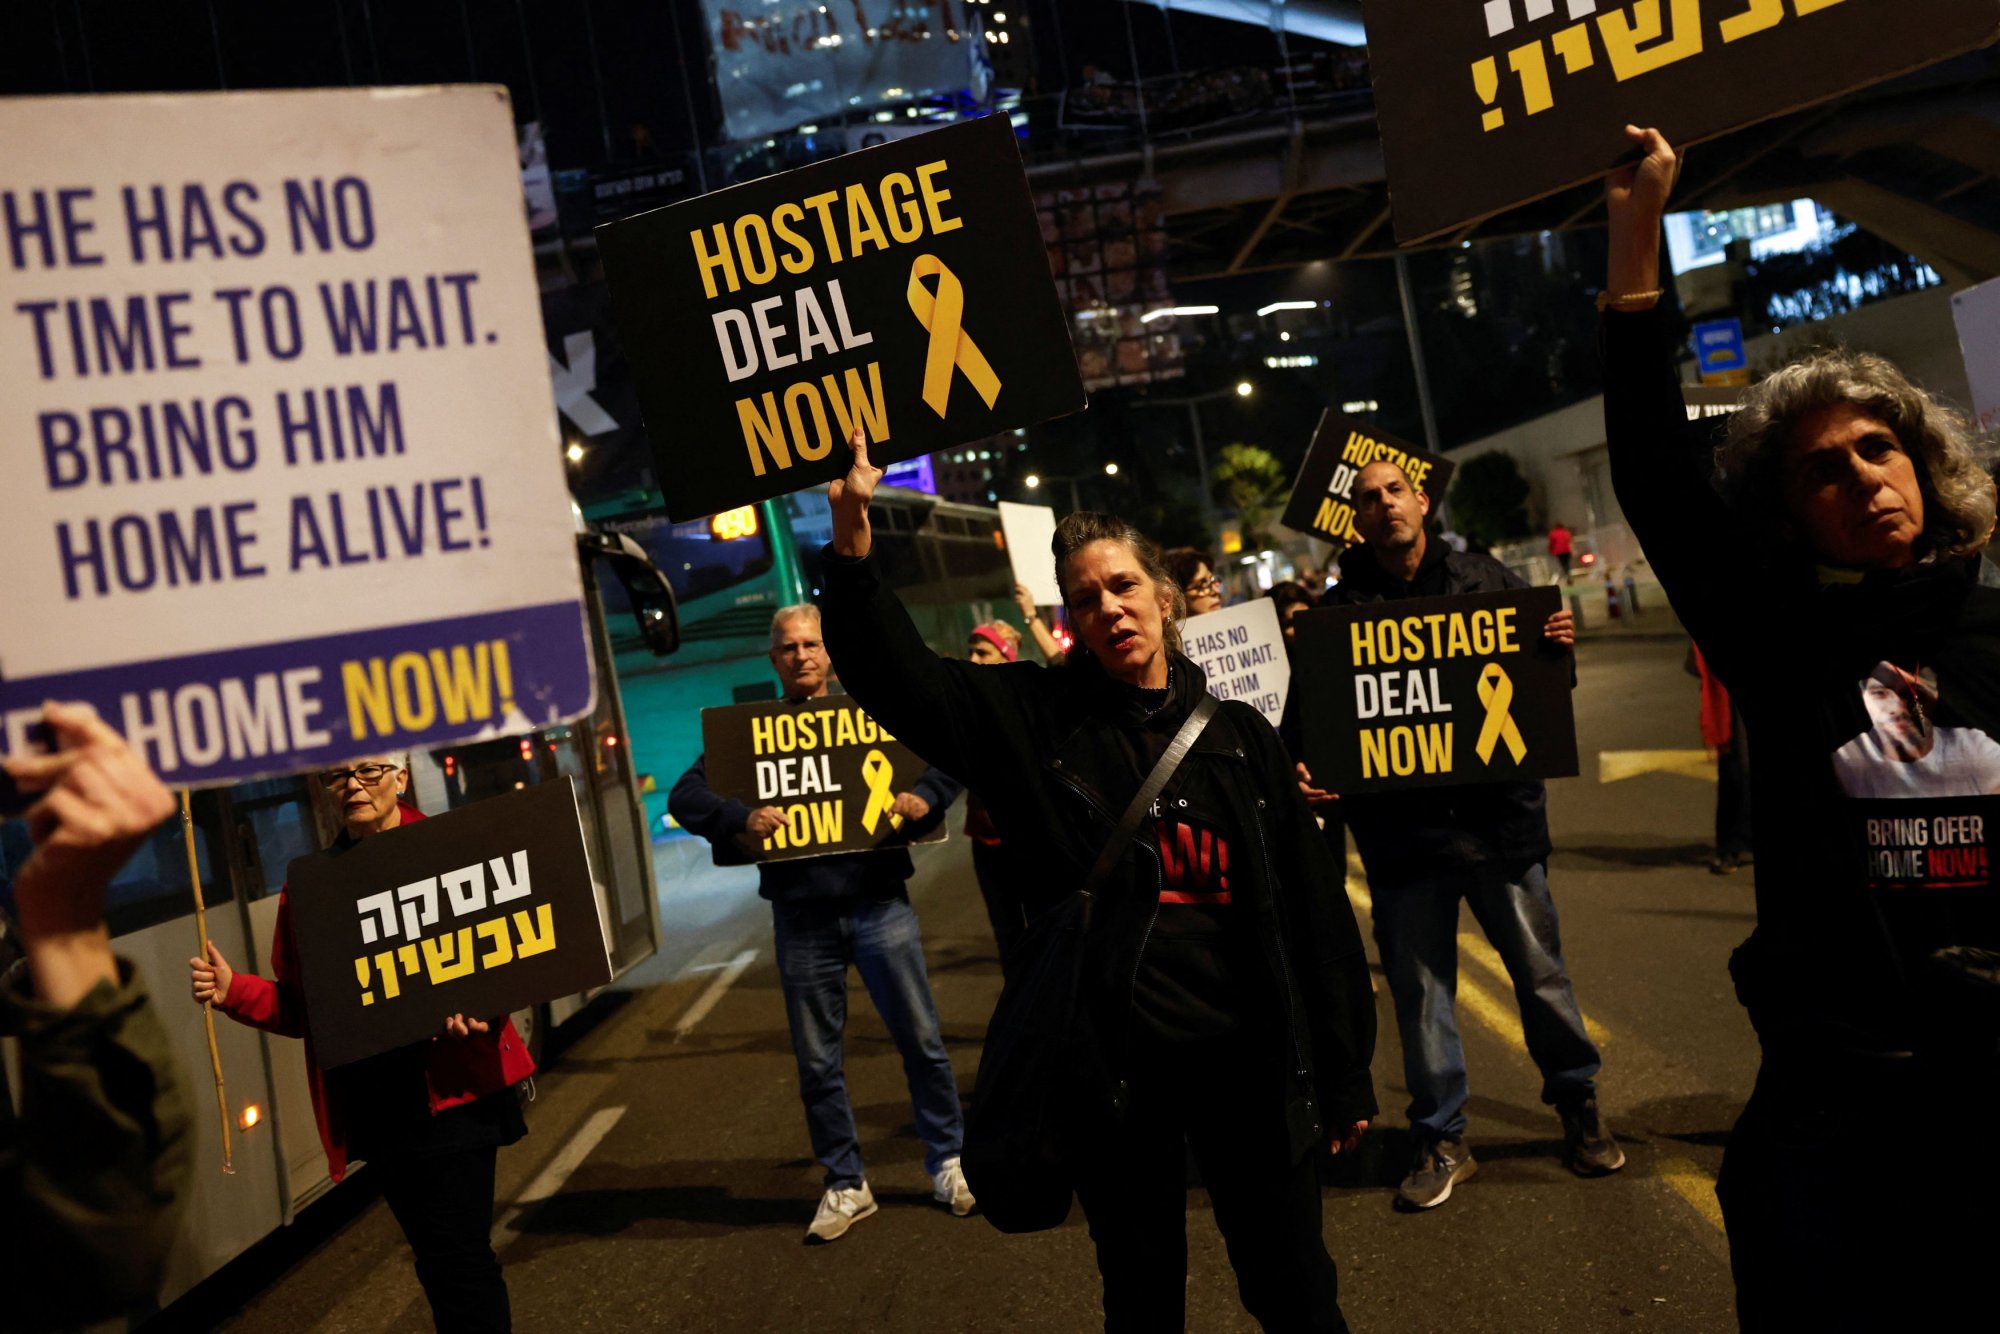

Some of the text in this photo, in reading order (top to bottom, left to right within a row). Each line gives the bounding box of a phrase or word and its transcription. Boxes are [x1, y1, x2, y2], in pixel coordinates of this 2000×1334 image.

[2, 176, 376, 269] HE HAS NO
[690, 159, 963, 299] HOSTAGE
[16, 272, 498, 379] TIME TO WAIT.
[711, 278, 874, 383] DEAL
[38, 382, 406, 491] BRING HIM
[735, 361, 891, 477] NOW
[1328, 463, 1358, 499] DE
[56, 476, 493, 600] HOME ALIVE!
[1196, 632, 1226, 656] HAS
[1228, 625, 1248, 646] NO
[1217, 654, 1236, 674] TO
[1237, 643, 1279, 670] WAIT.
[1350, 607, 1520, 666] HOSTAGE
[121, 666, 332, 772] HOME
[341, 639, 515, 741] NOW!
[1231, 673, 1260, 696] HIM
[1253, 692, 1281, 715] IVE!
[1354, 667, 1452, 719] DEAL
[755, 754, 842, 800] DEAL
[1360, 722, 1453, 779] NOW
[1866, 814, 1985, 847] BRING OFER
[1866, 846, 1989, 879] HOME NOW!
[356, 849, 532, 944] עסקה
[354, 903, 556, 1006] עכשיו!
